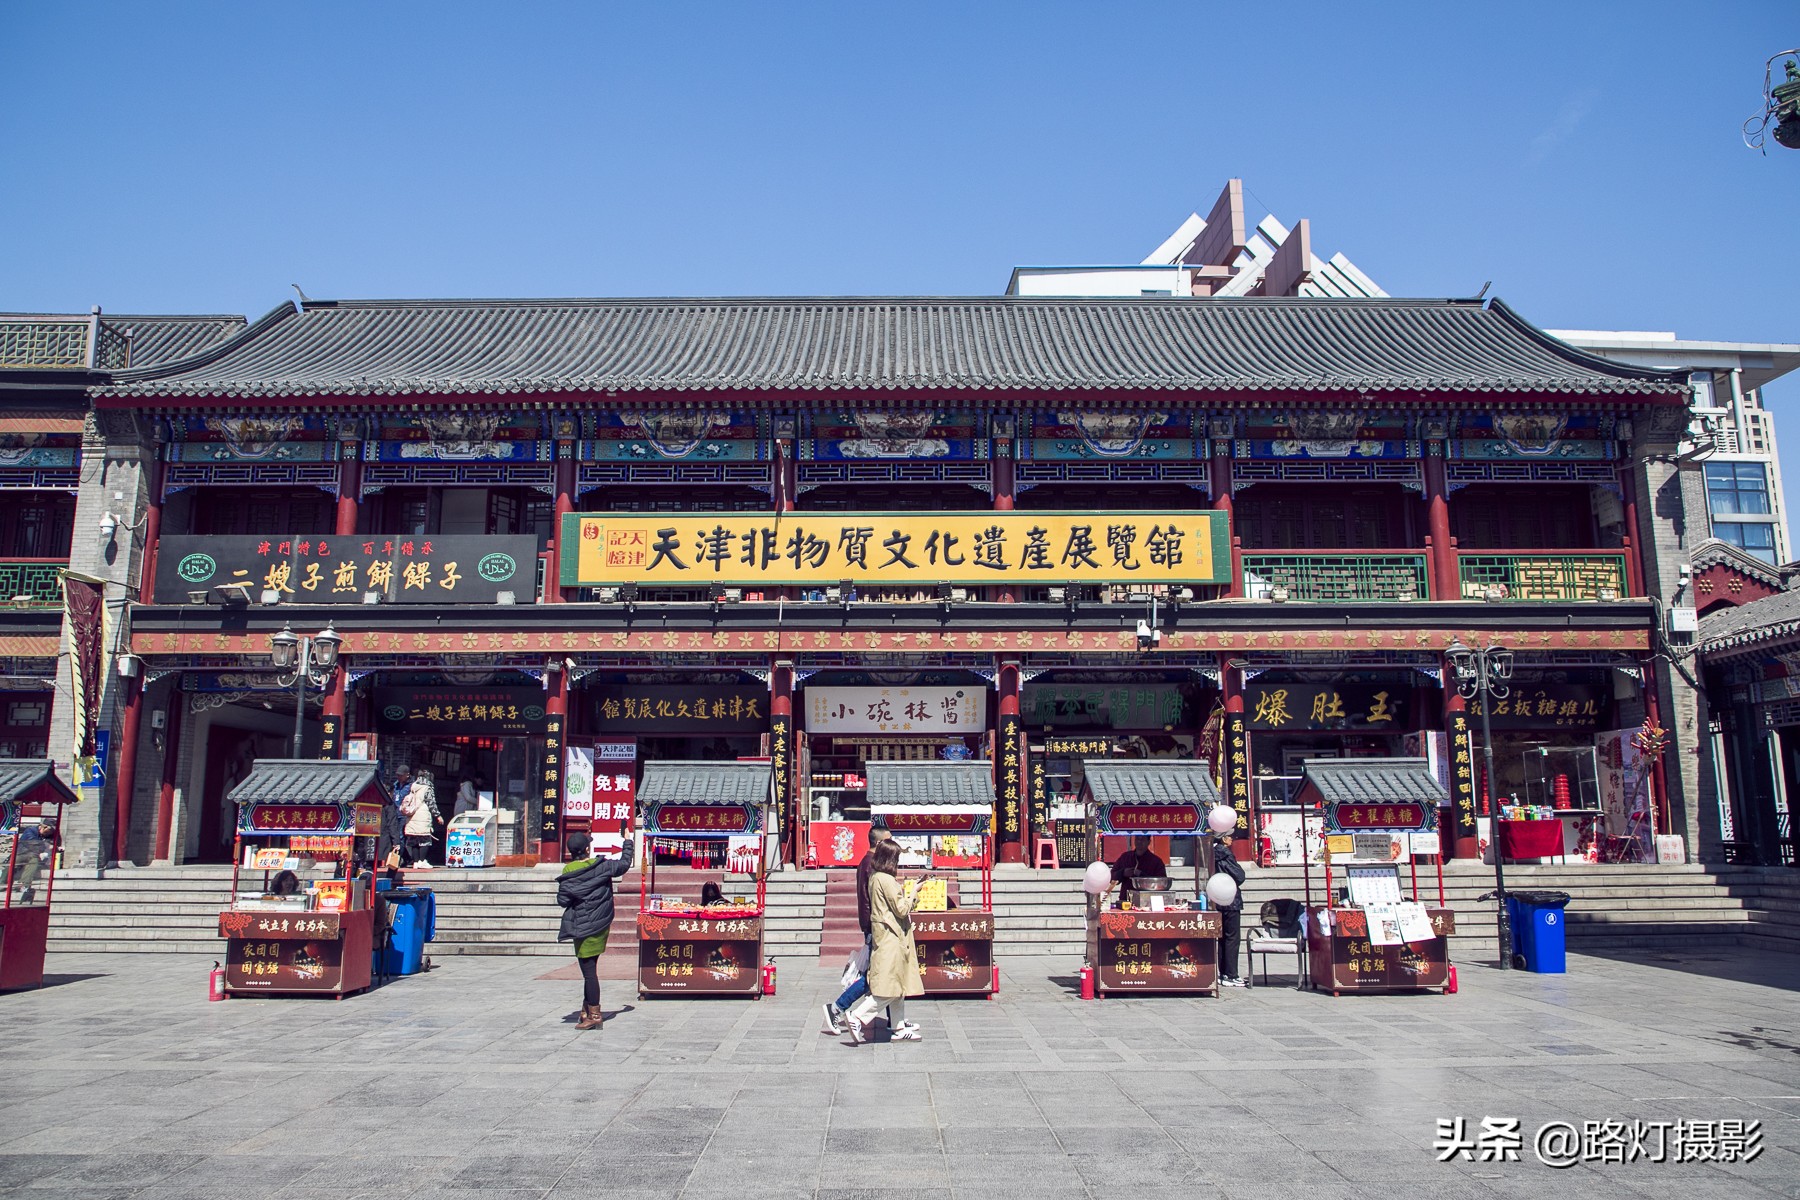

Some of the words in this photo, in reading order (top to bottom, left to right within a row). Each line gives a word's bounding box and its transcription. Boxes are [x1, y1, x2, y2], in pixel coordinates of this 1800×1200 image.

[646, 523, 1186, 572] 天津非物質文化遺產展覽館
[1253, 689, 1393, 727] 爆肚王
[603, 745, 634, 753] 天津記憶
[595, 773, 631, 792] 免費
[594, 802, 631, 820] 開放
[259, 918, 289, 933] 诚立身
[294, 918, 328, 933] 信为本
[678, 919, 710, 934] 诚立身
[715, 919, 749, 934] 信为本
[951, 920, 988, 933] 文化南开
[1137, 919, 1175, 931] 做文明人
[242, 942, 280, 957] 家团圆
[655, 944, 694, 960] 家团圆
[1114, 942, 1151, 957] 家团圆
